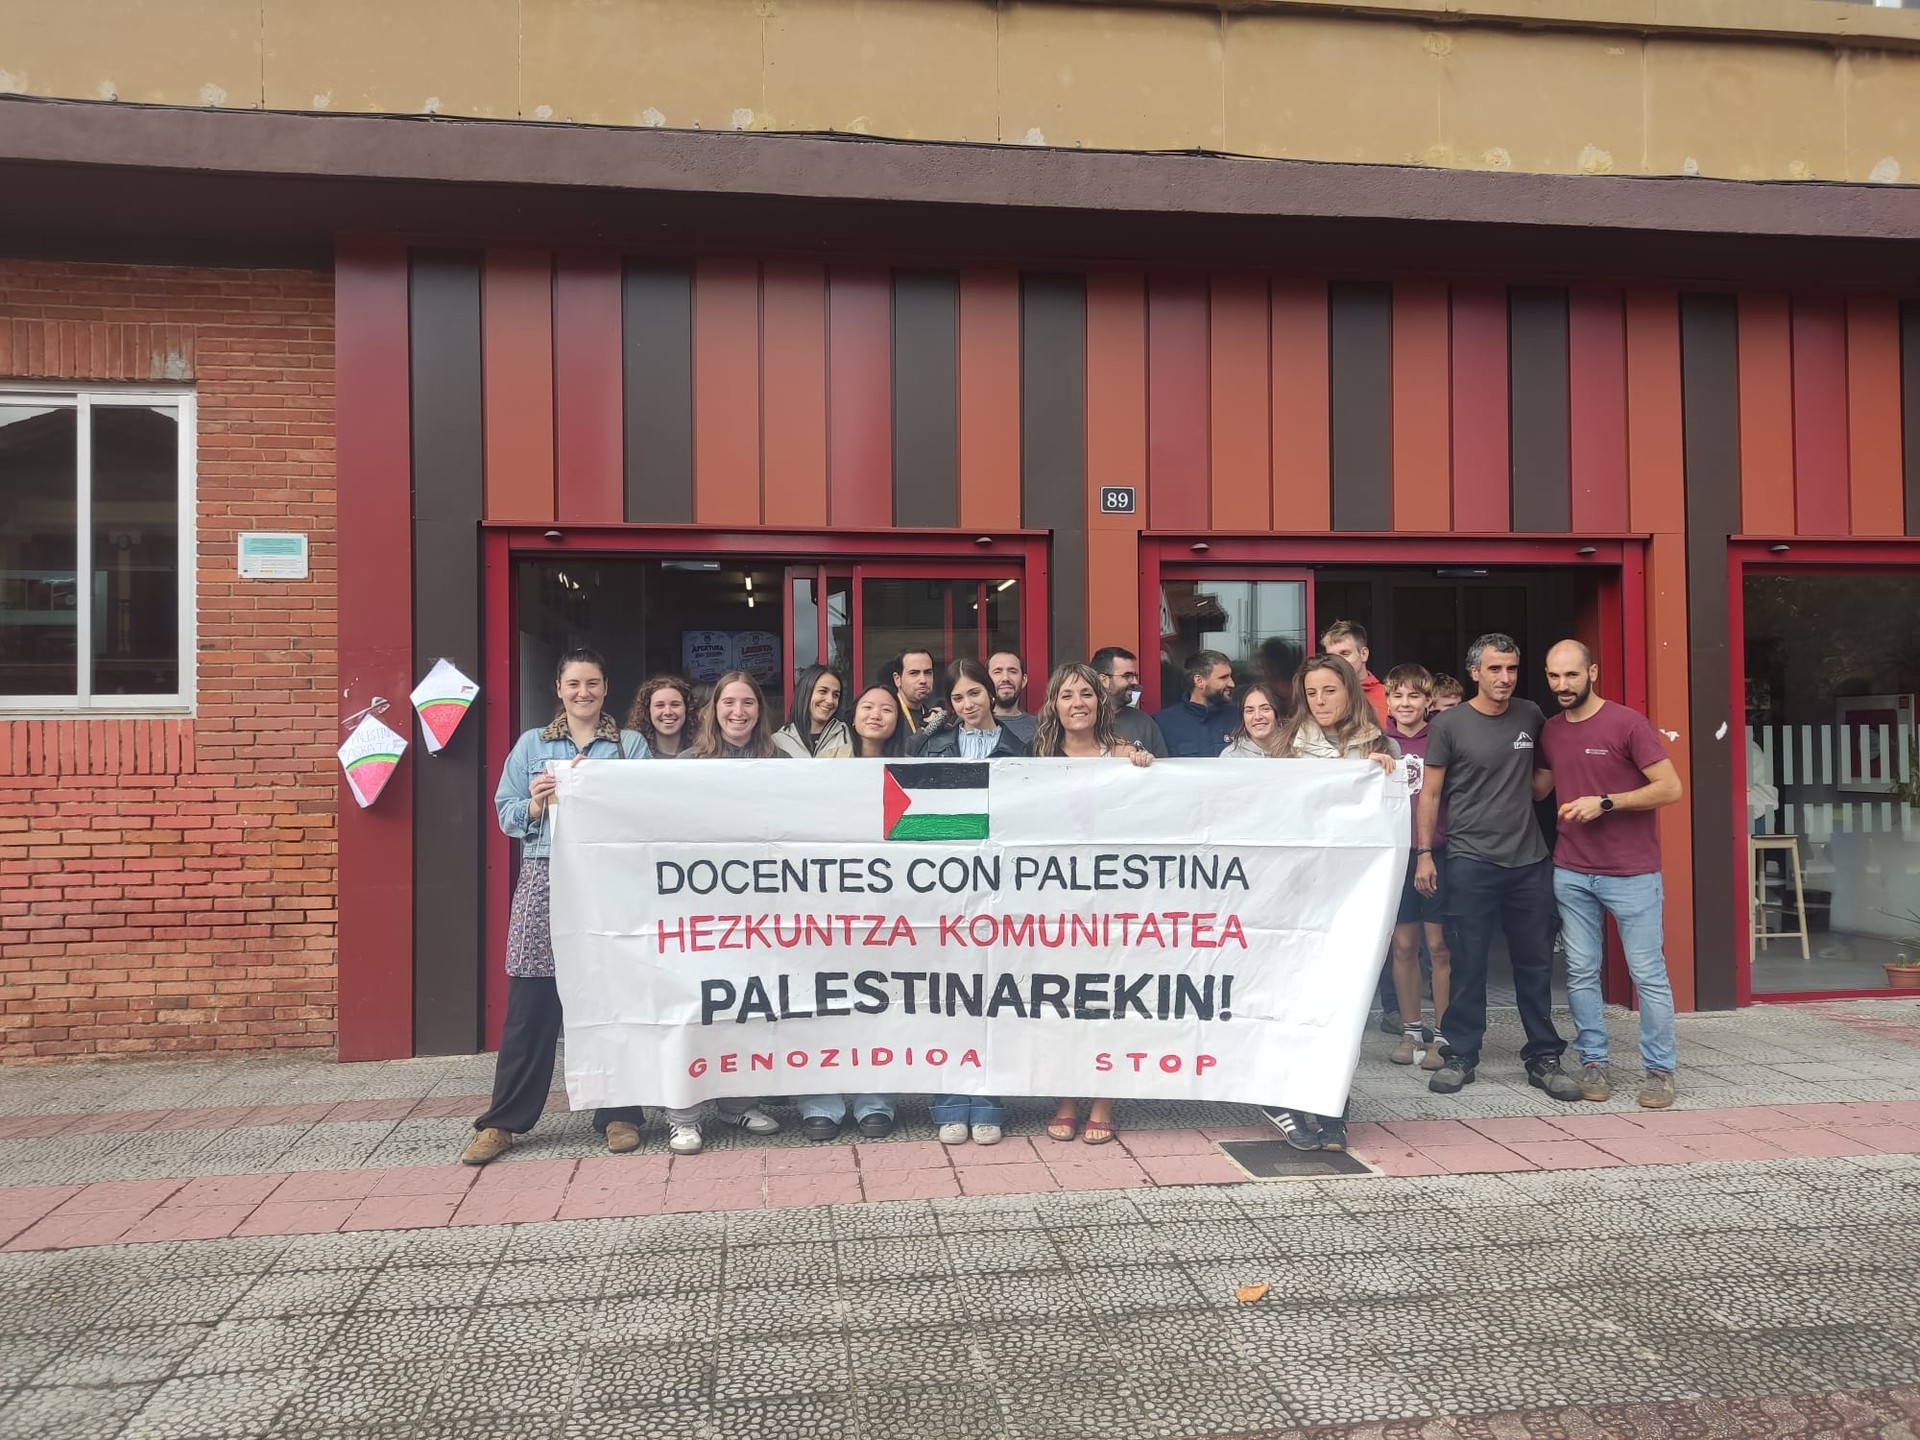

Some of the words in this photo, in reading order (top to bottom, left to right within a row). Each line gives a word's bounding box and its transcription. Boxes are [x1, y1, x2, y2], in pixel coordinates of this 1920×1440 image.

[1107, 492, 1128, 508] 89
[656, 857, 894, 895] DOCENTES
[906, 855, 1001, 894] CON
[1015, 854, 1250, 891] PALESTINA
[658, 912, 916, 953] HEZKUNTZA
[939, 911, 1247, 949] KOMUNITATEA
[701, 970, 1234, 1026] PALESTINAREKIN!
[688, 1047, 983, 1078] GENOZIDIOA
[1095, 1052, 1218, 1076] STOP
